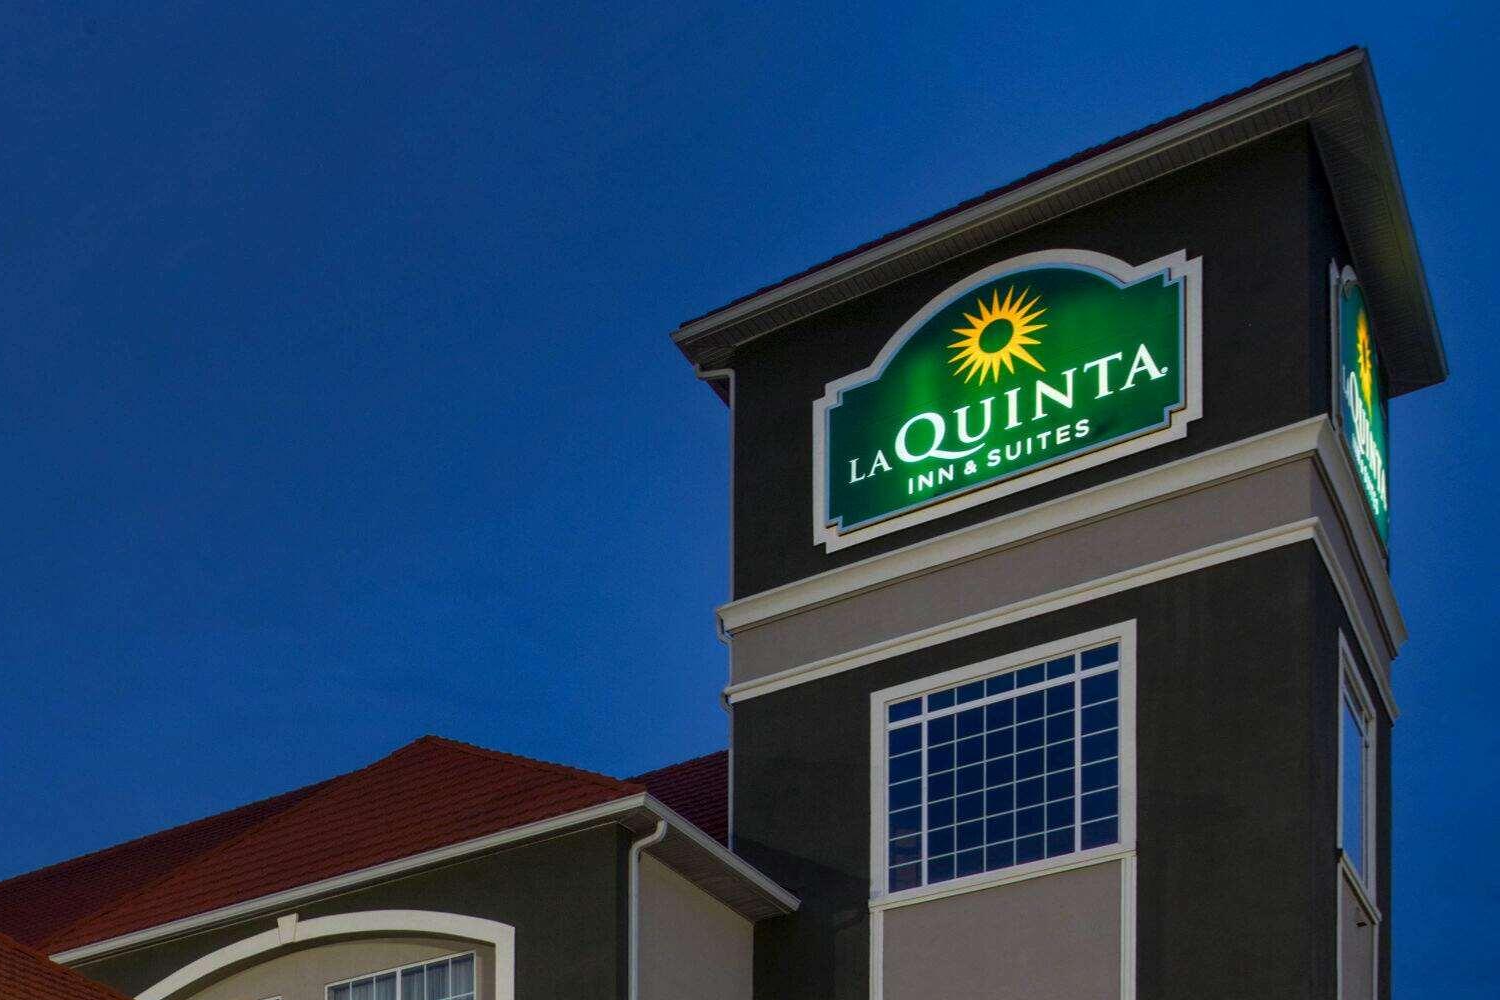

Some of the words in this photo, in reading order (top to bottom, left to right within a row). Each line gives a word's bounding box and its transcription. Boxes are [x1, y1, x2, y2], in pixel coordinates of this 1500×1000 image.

[848, 449, 892, 484] LA
[894, 343, 1168, 464] QUINTA
[907, 464, 954, 495] INN
[963, 460, 978, 476] &
[986, 418, 1090, 468] SUITES
